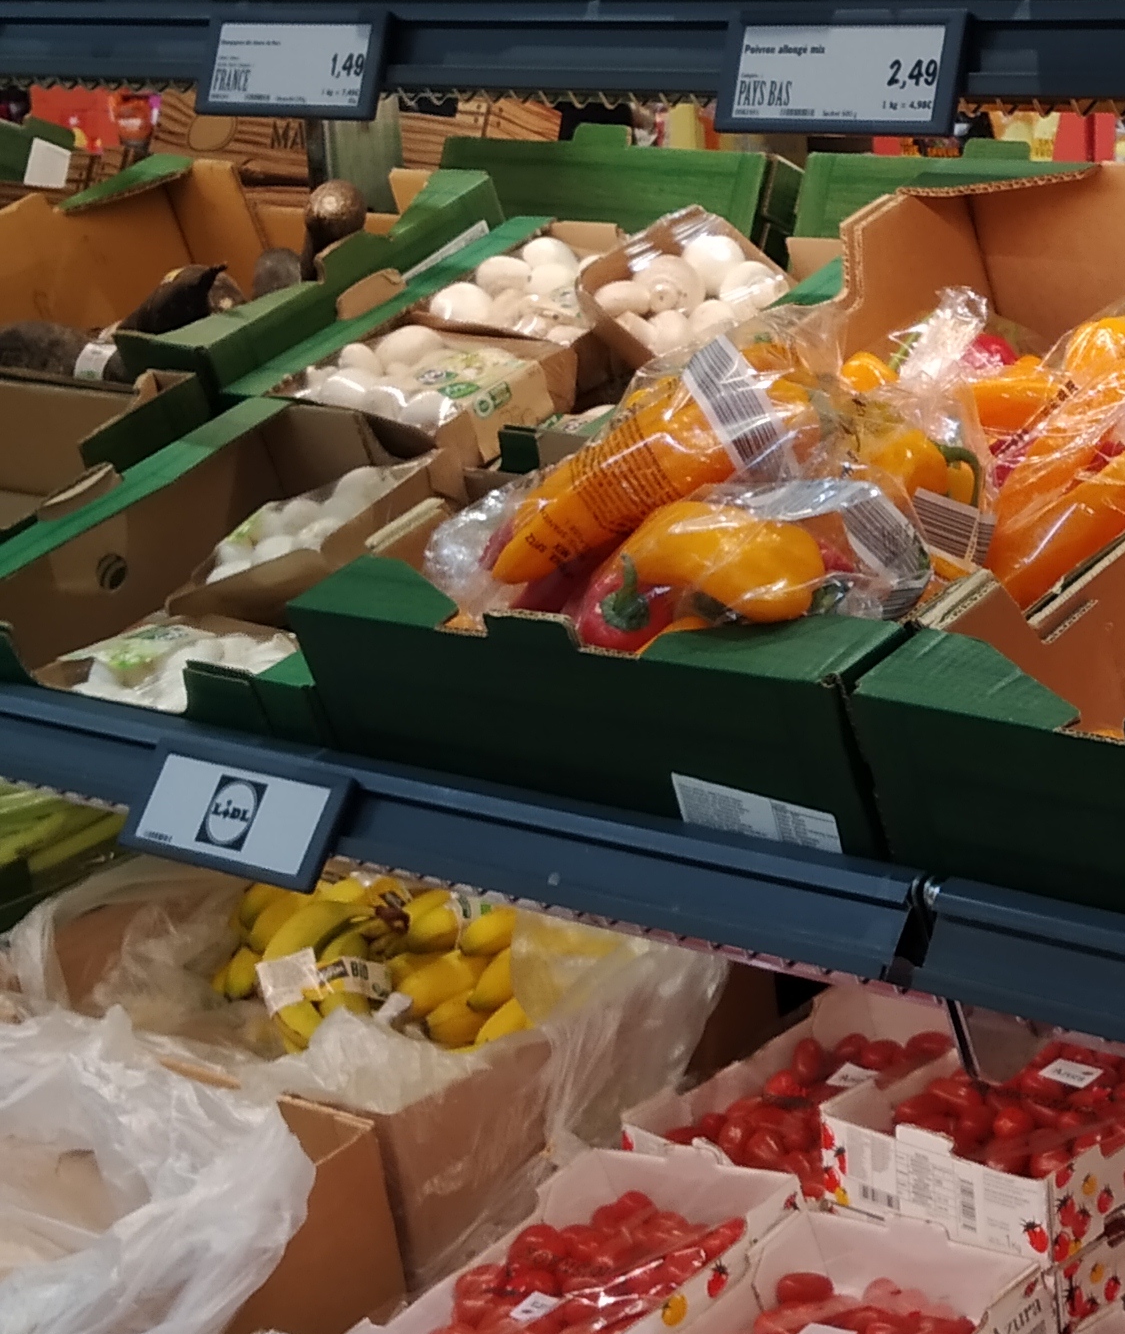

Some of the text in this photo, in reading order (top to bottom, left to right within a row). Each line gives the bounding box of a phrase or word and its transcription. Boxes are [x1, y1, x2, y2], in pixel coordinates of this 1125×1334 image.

[330, 52, 366, 78] 1,49
[886, 59, 939, 89] 2,49
[213, 68, 251, 92] FRANCE
[736, 80, 793, 107] PAYS BAS
